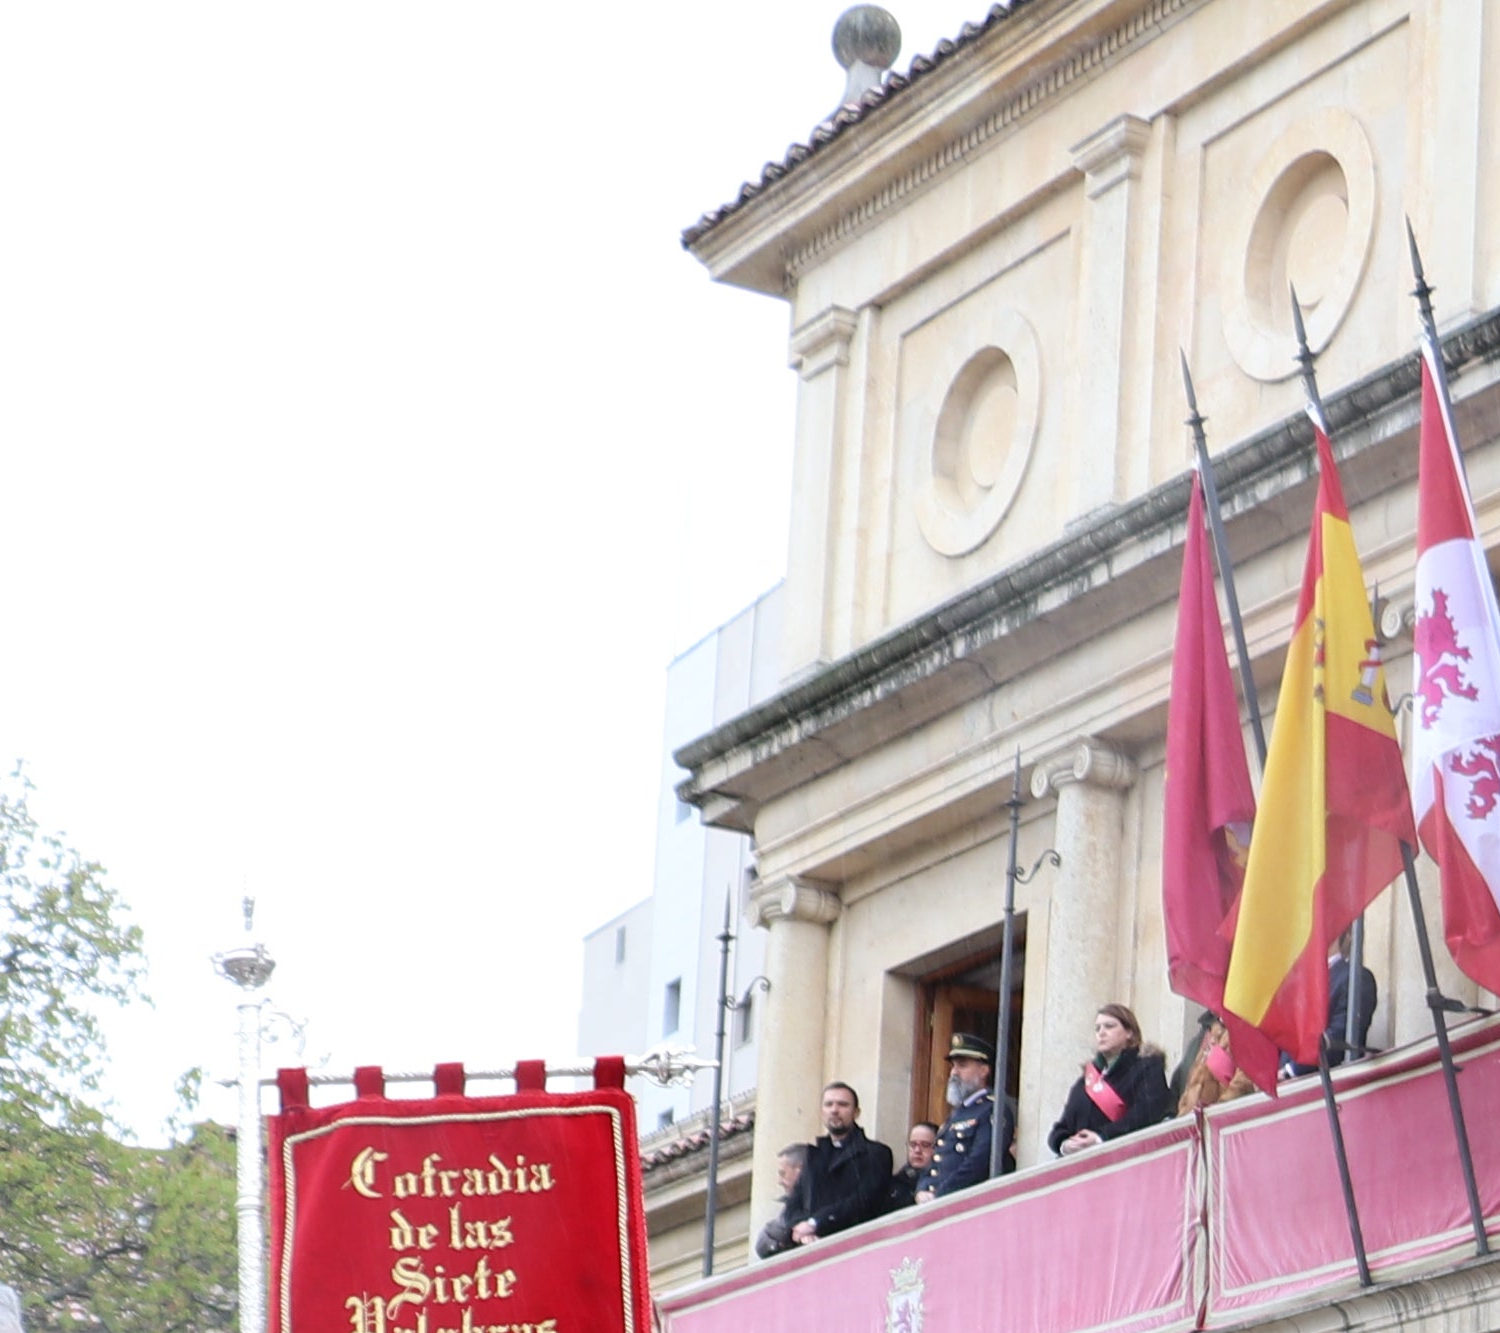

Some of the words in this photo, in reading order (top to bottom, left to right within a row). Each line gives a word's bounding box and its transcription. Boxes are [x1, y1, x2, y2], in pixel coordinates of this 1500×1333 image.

[389, 1208, 439, 1250] de
[449, 1201, 514, 1250] las
[388, 1255, 517, 1318] Siete
